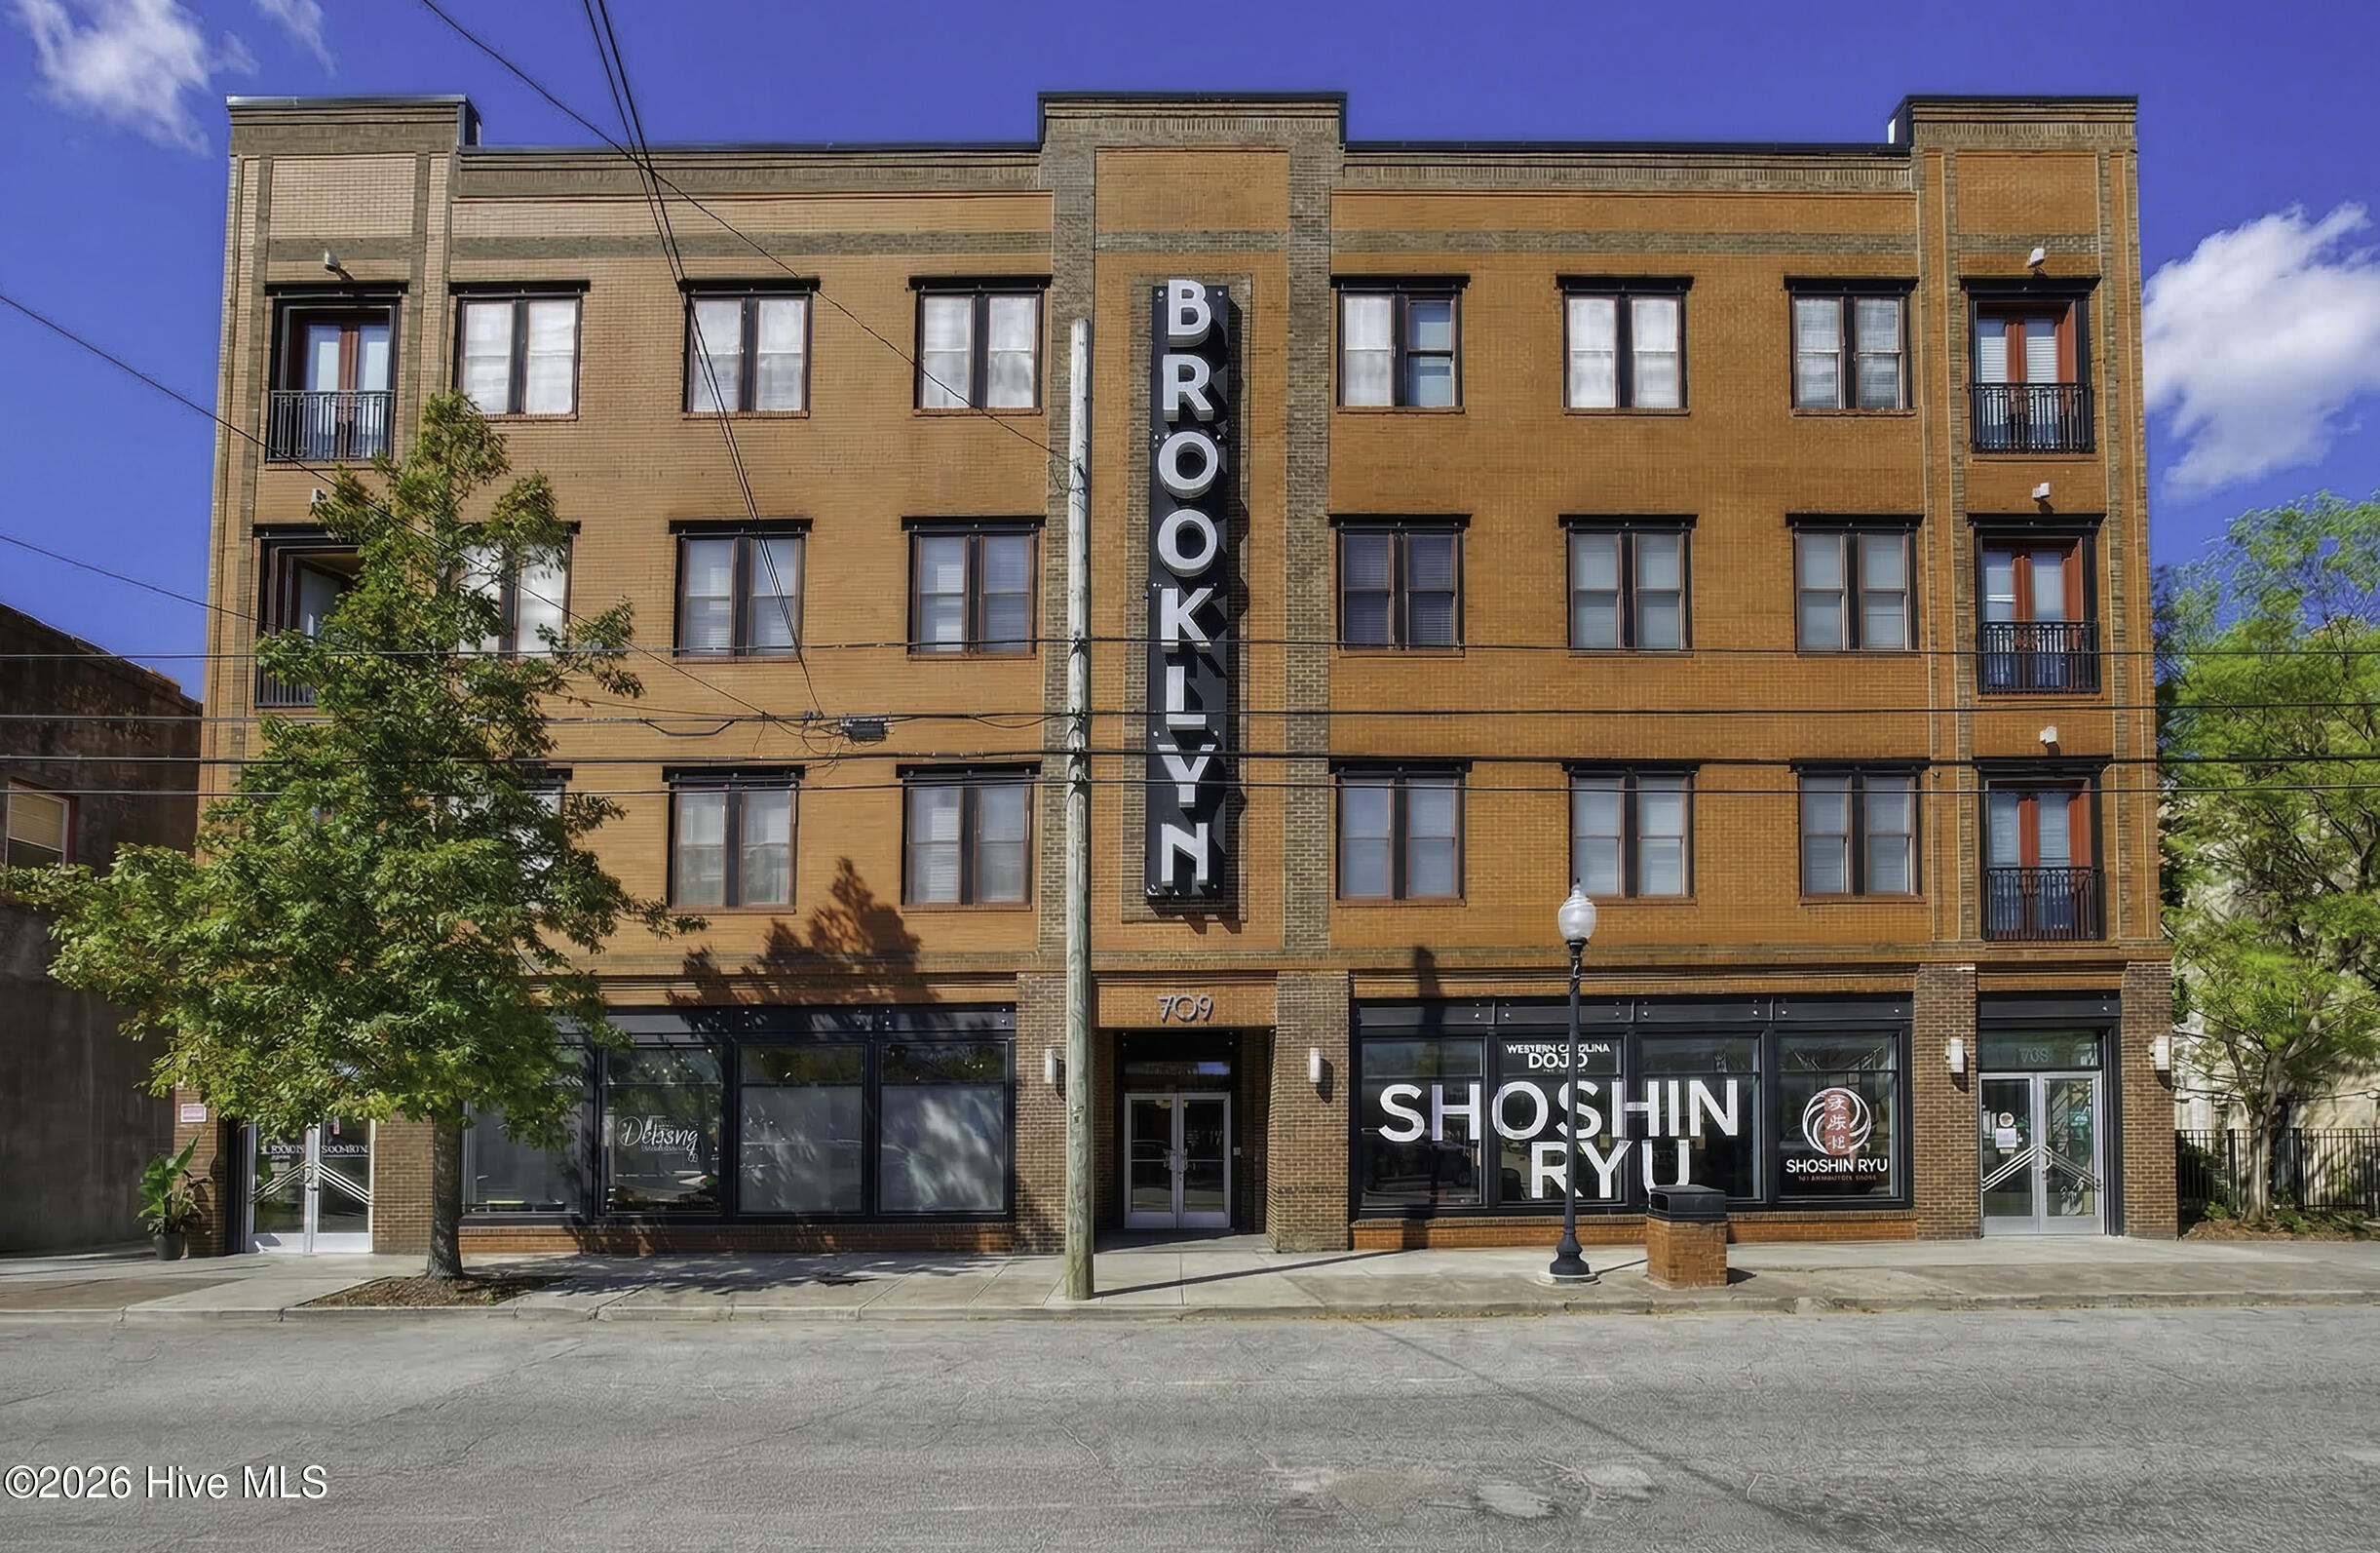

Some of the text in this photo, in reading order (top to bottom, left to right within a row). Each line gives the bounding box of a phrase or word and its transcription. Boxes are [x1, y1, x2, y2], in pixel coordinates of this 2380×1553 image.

[1157, 279, 1219, 888] BROOKLYN
[1157, 993, 1213, 1024] 709
[1506, 1043, 1611, 1054] WESTERN COLINA
[1528, 1053, 1589, 1068] DOJO
[1378, 1079, 1738, 1142] SHOSHIN
[1531, 1139, 1689, 1199] RYU
[1785, 1158, 1888, 1173] SHOSHIN RYU
